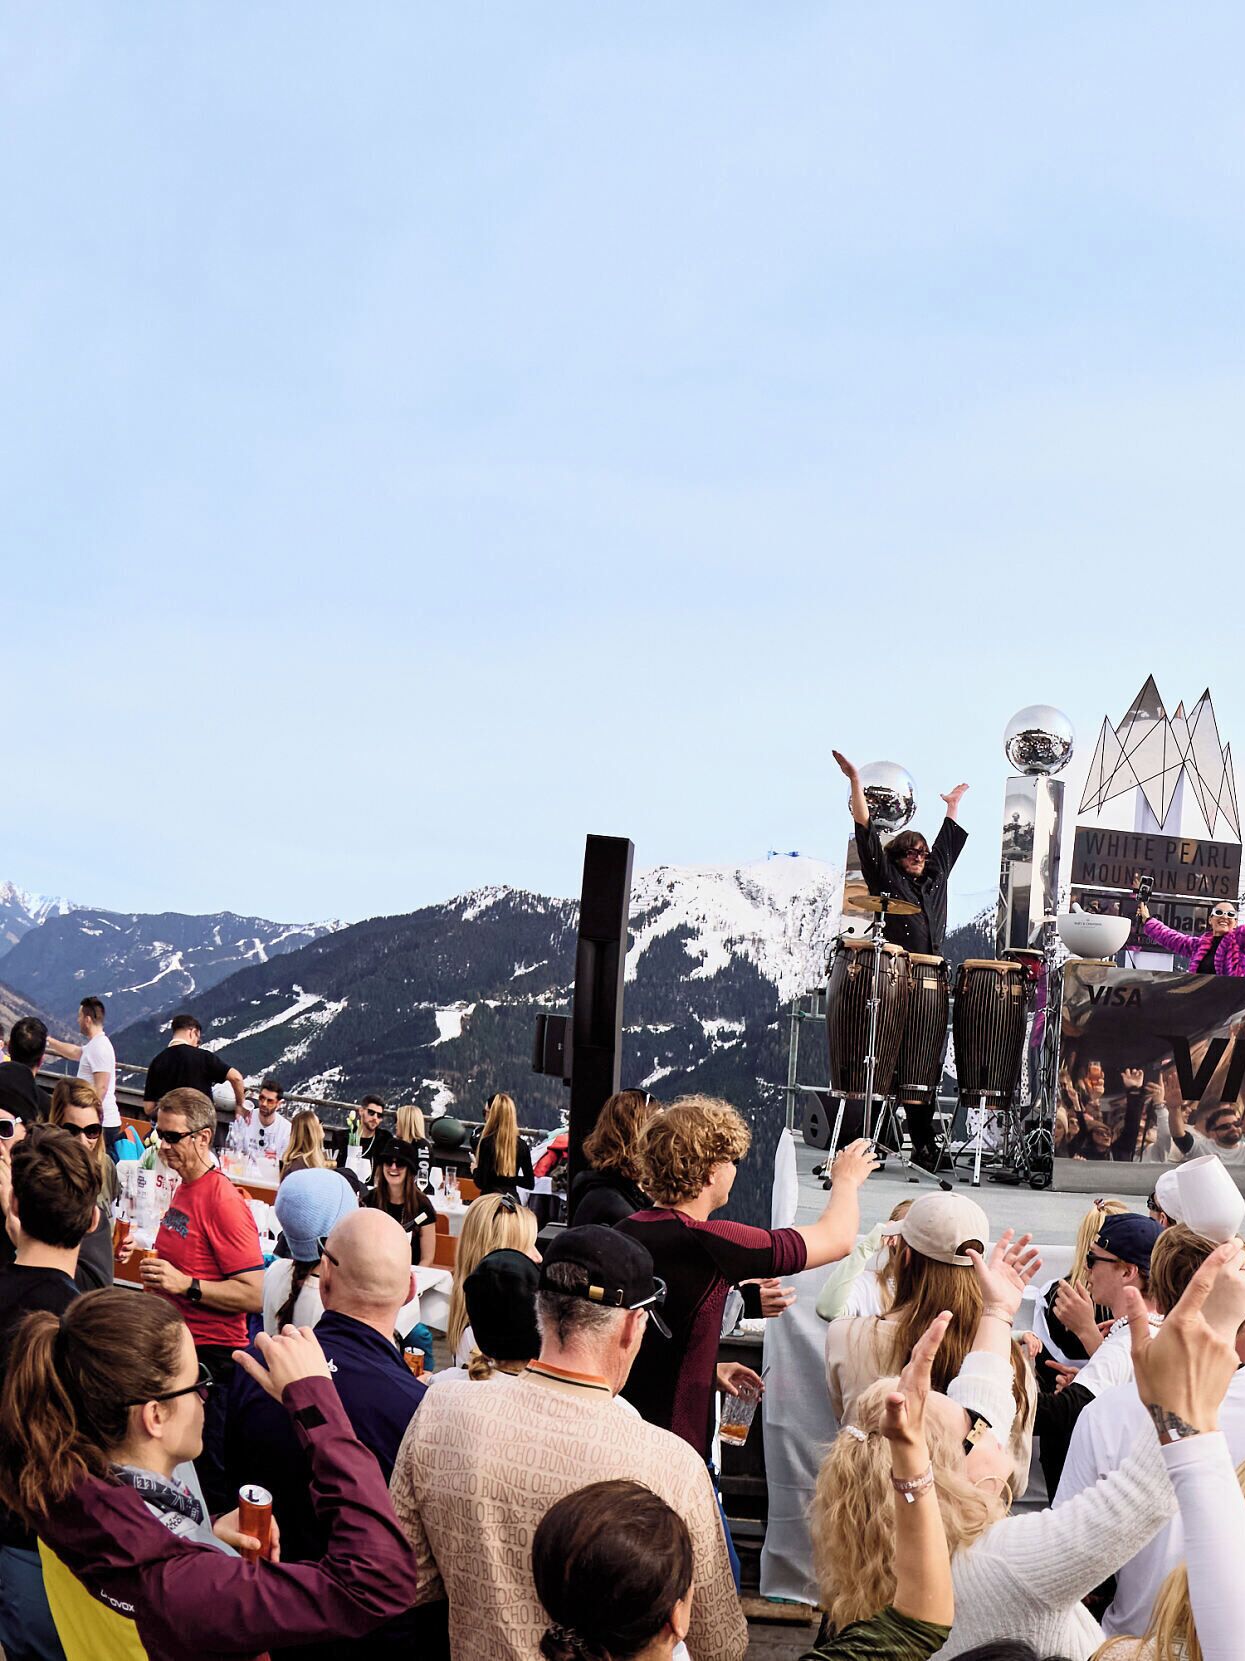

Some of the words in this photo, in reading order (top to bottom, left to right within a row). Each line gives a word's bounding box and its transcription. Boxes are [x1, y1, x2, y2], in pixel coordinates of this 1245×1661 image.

[1085, 831, 1155, 862] WHITE
[1165, 842, 1232, 870] PEARL
[1186, 872, 1230, 895] DAYS
[1086, 984, 1142, 1009] VISA
[486, 1419, 540, 1445] PSYCHO
[497, 1400, 543, 1428] BUNNY
[600, 1425, 649, 1454] BUNNY
[438, 1450, 479, 1472] PSYCHO
[443, 1425, 482, 1453] BUNNY
[483, 1443, 537, 1468] PSYCHO
[537, 1448, 587, 1479] BUNNY
[481, 1459, 529, 1492] BUNNY
[436, 1471, 479, 1496] PSYCHO
[481, 1476, 529, 1508] BUNNY
[475, 1501, 528, 1525] PSYCHO
[477, 1524, 529, 1547] PSYCHO
[482, 1561, 527, 1586] BUNNY
[480, 1583, 529, 1606] PSYCHO
[483, 1603, 530, 1625] PSYCHO
